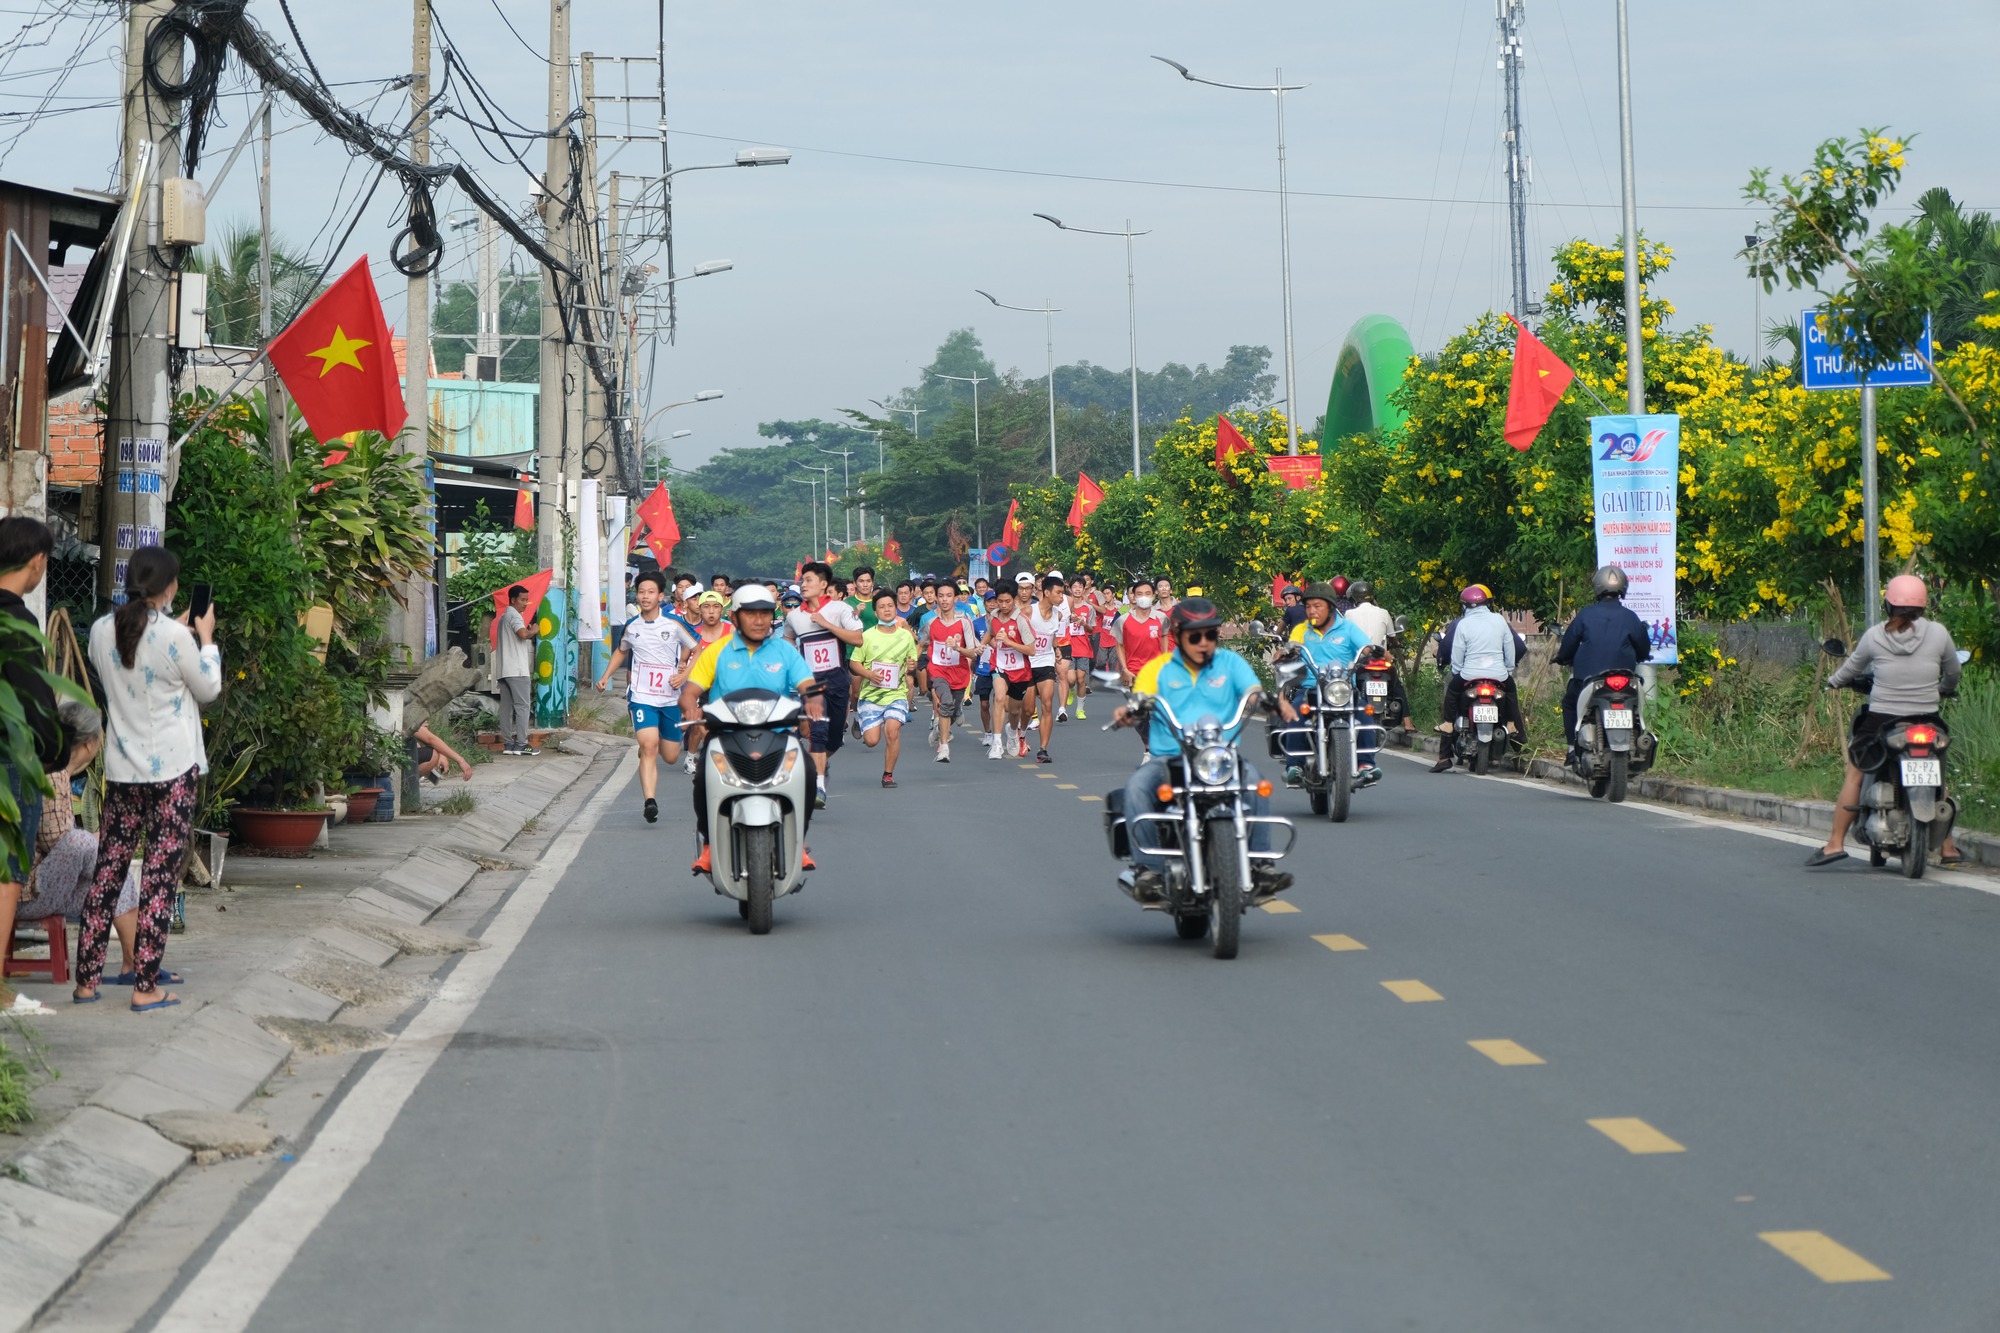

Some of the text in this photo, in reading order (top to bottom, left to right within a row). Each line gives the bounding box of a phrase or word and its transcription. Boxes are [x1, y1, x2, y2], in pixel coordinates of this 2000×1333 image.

[121, 443, 134, 461] 098
[138, 443, 150, 462] 600
[1660, 522, 1671, 533] 2023
[814, 647, 830, 664] 82
[940, 647, 951, 660] 6
[649, 671, 663, 688] 12
[636, 709, 644, 723] 9
[1907, 762, 1934, 773] 62-P2
[1905, 774, 1938, 785] 136.21
